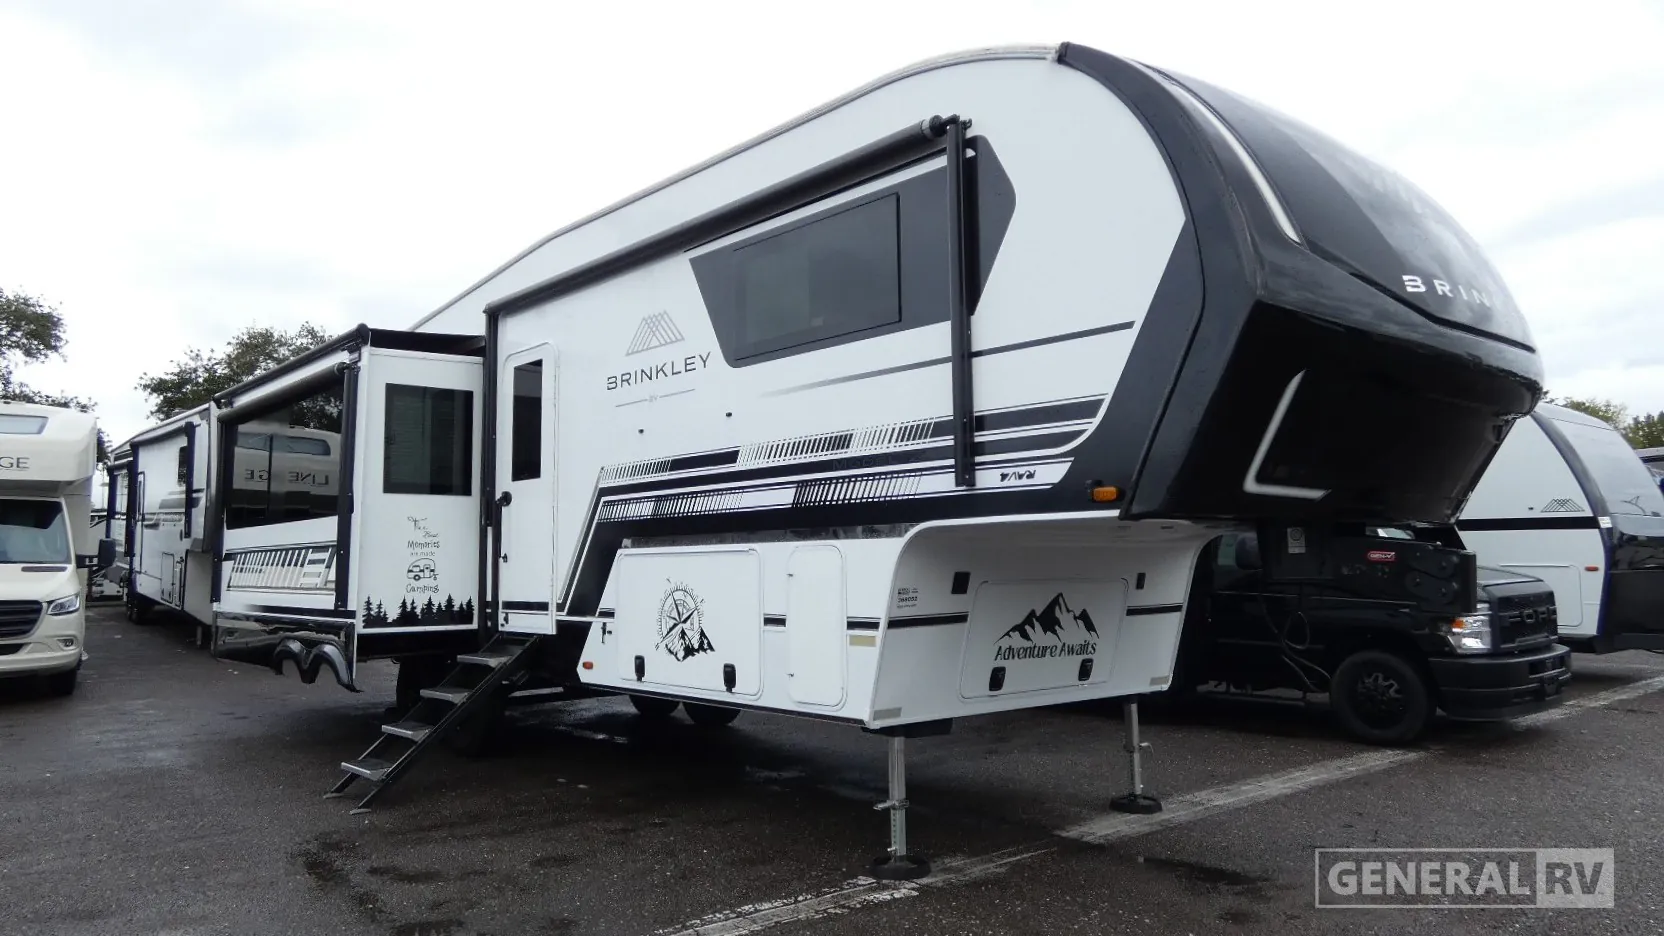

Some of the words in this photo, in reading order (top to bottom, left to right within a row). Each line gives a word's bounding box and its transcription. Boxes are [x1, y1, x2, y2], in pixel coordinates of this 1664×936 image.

[607, 351, 711, 390] BRINKLEY
[407, 540, 440, 550] Memories
[406, 583, 440, 594] Camping
[994, 643, 1058, 661] Adventure
[1058, 640, 1097, 657] Awaits
